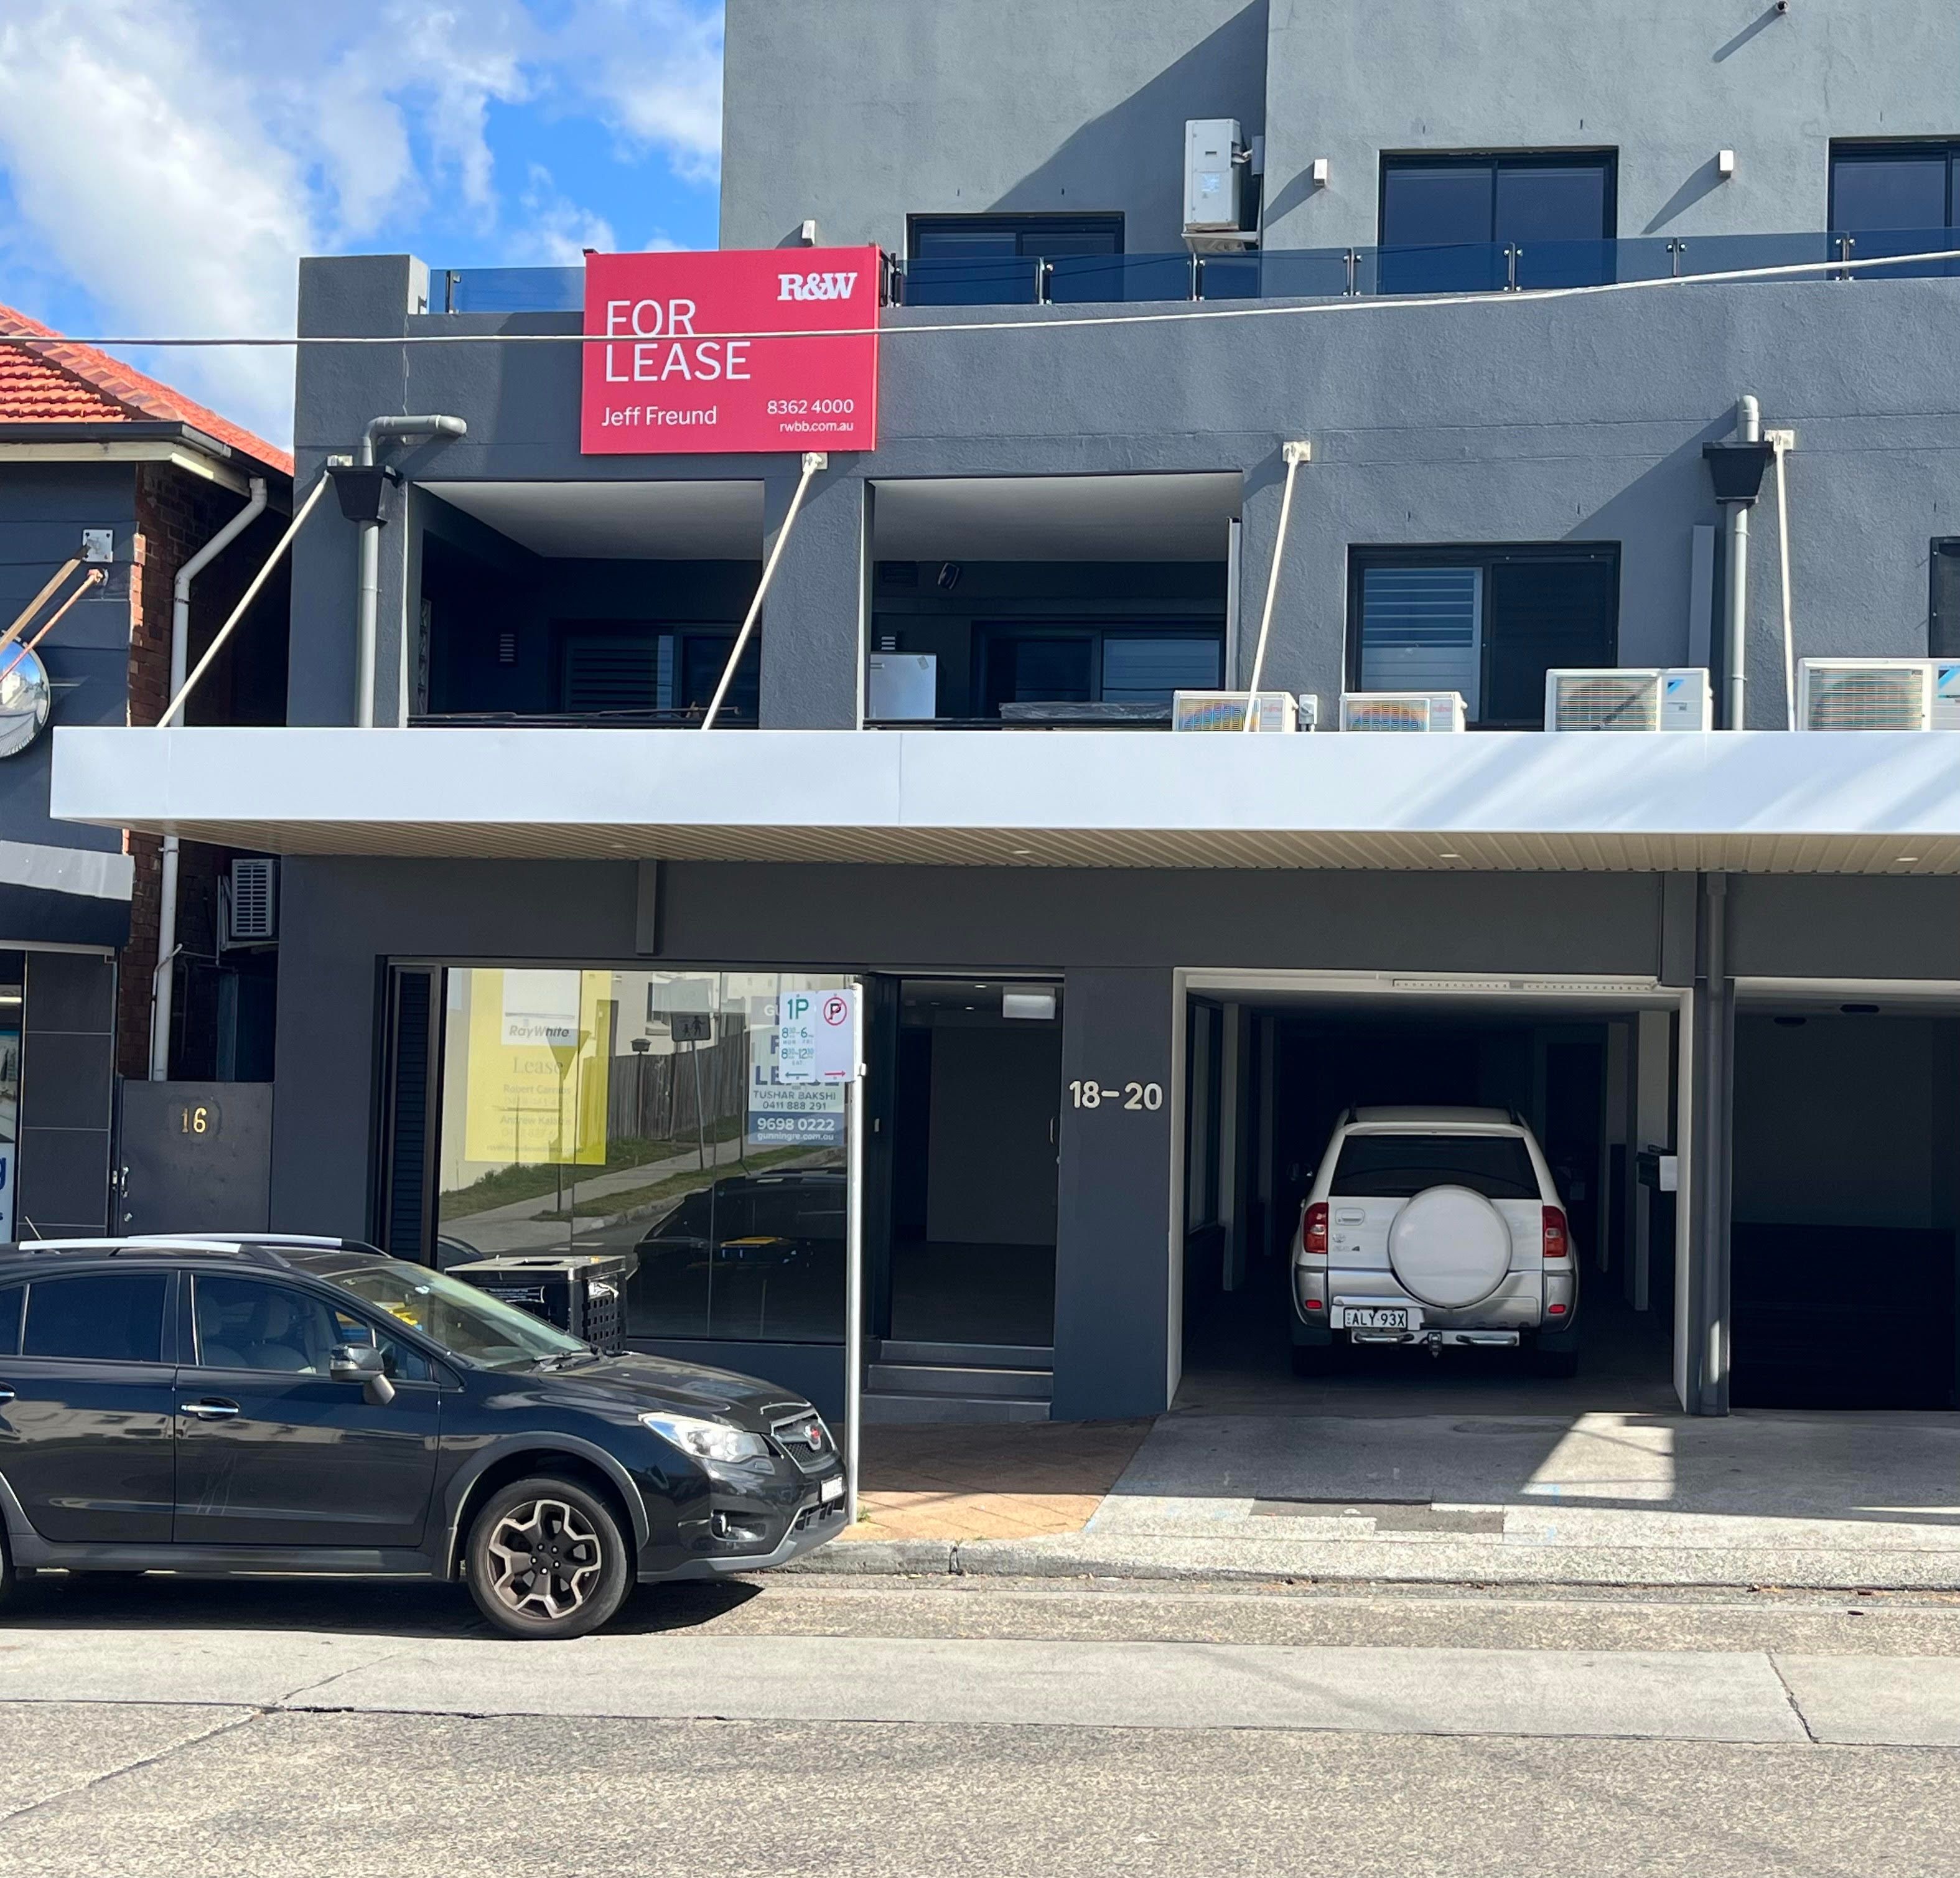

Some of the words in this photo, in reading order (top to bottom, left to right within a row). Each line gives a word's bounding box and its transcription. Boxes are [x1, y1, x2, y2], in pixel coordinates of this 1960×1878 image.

[777, 273, 858, 301] R&W
[607, 299, 696, 336] FOR
[605, 342, 751, 381] LEASE
[601, 406, 641, 426] Jeff
[646, 405, 717, 426] Freund
[767, 399, 808, 414] 8362
[811, 399, 854, 414] 4000
[780, 421, 854, 432] rwbb.com.au
[787, 998, 809, 1020] 1P
[513, 1057, 564, 1075] Lease
[754, 1090, 795, 1100] TUSHAR
[798, 1091, 836, 1101] BAKSHI
[763, 1101, 784, 1109] 0411
[786, 1101, 806, 1110] 888
[810, 1102, 826, 1111] 291
[181, 1107, 207, 1134] 16
[757, 1118, 795, 1131] 9698
[797, 1118, 835, 1131] 0222
[757, 1132, 834, 1141] gunningre.com.au
